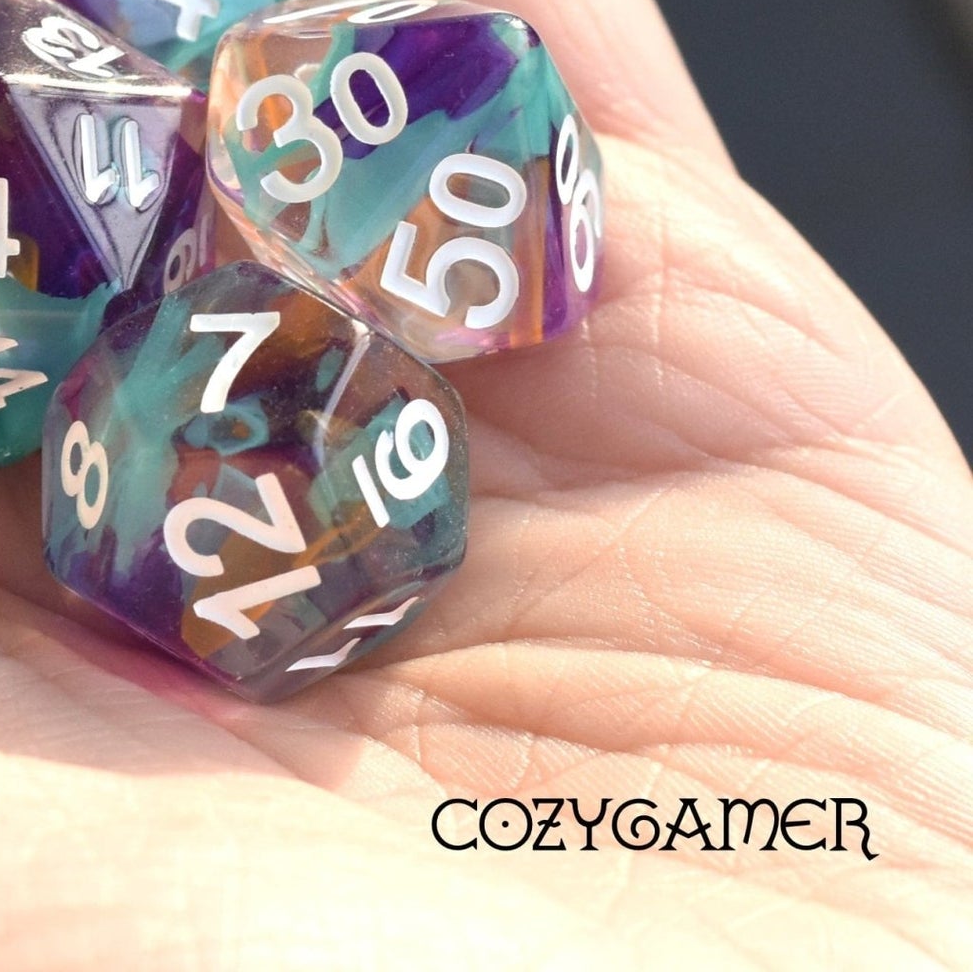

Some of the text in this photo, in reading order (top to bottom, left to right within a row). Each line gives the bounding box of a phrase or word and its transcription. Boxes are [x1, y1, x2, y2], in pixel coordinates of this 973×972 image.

[78, 112, 160, 212] 11
[235, 51, 408, 204] 30
[380, 152, 528, 330] 50
[189, 310, 281, 414] 7
[60, 420, 109, 529] 8
[163, 472, 322, 641] 12
